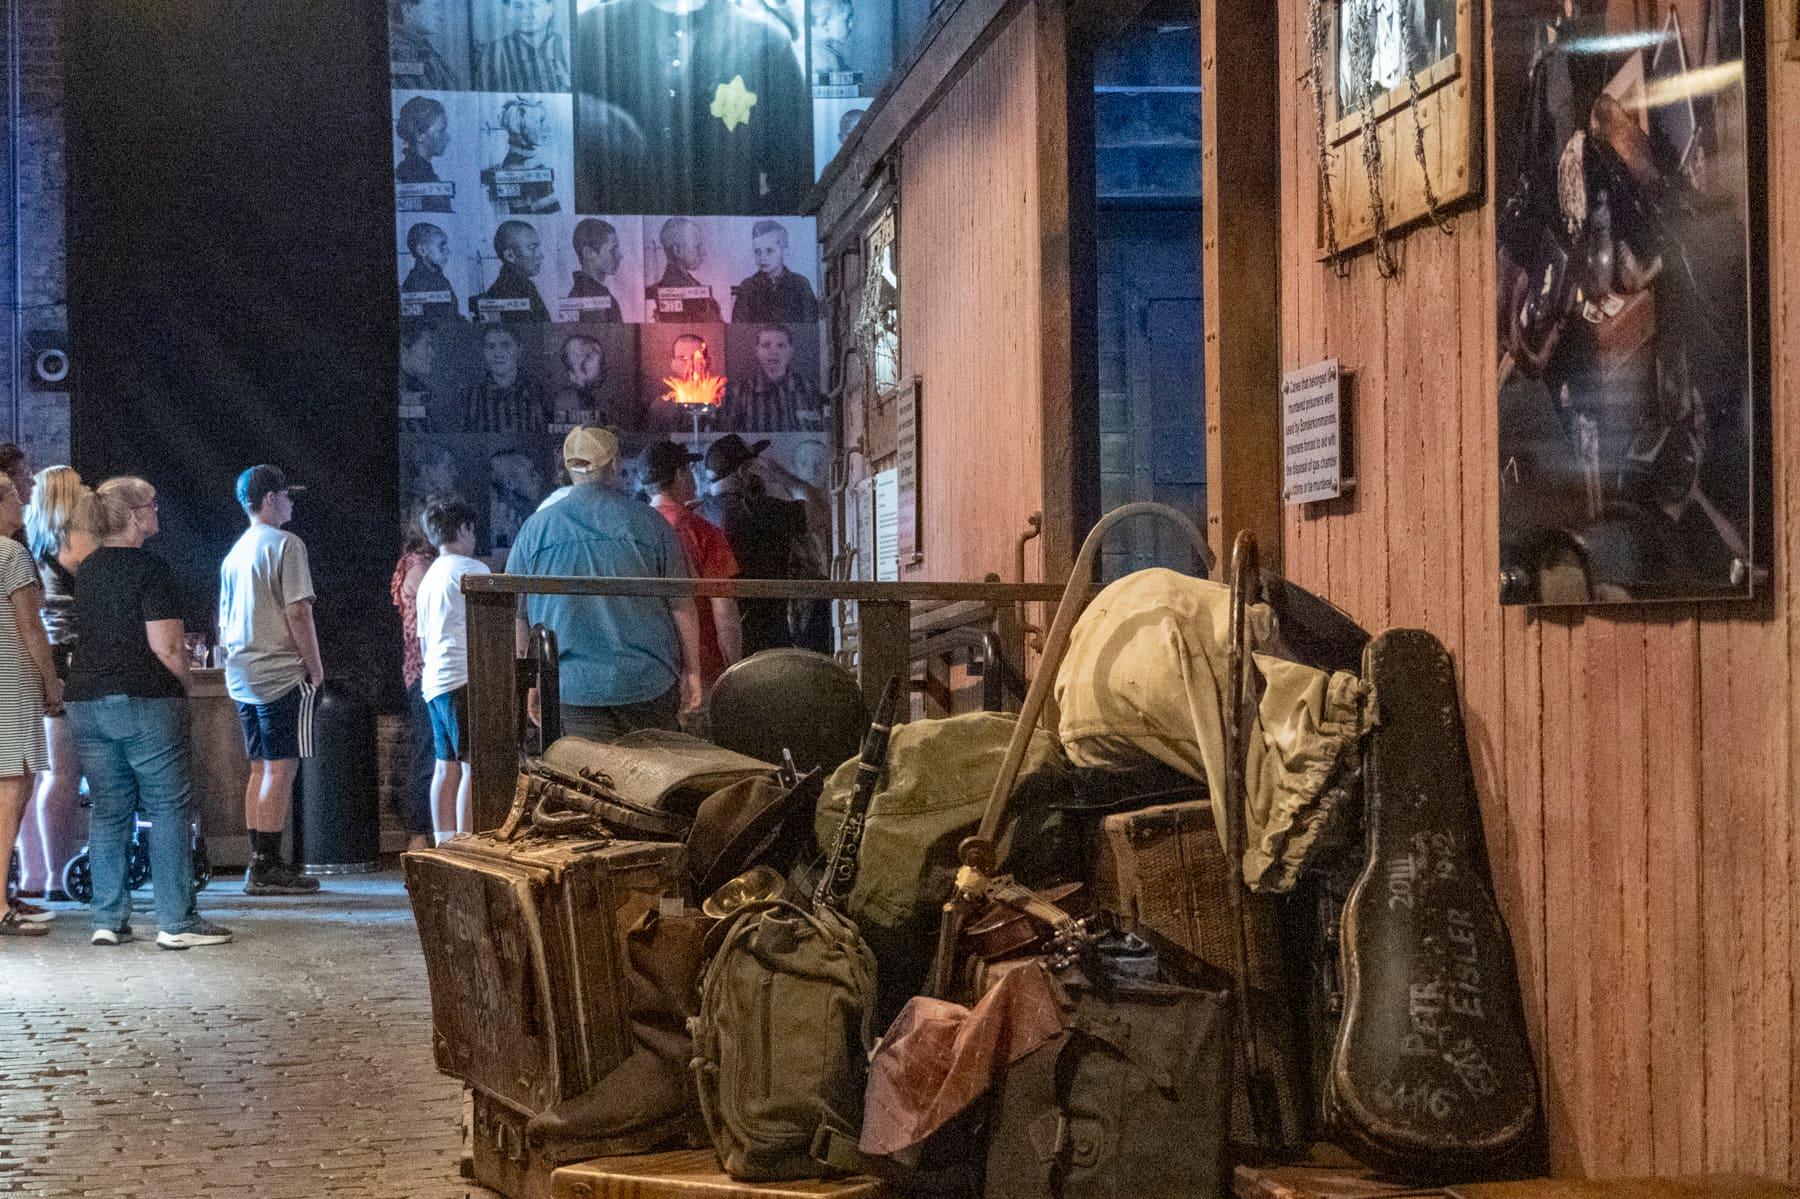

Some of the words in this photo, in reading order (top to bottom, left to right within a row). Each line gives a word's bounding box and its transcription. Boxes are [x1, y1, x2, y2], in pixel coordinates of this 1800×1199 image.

[1309, 373, 1326, 388] belonged
[1288, 397, 1305, 414] murdered
[1305, 395, 1323, 412] prisoners
[1286, 442, 1303, 458] prisoners
[1304, 438, 1316, 451] forced
[1292, 460, 1307, 477] disposal
[1320, 454, 1337, 469] chamber
